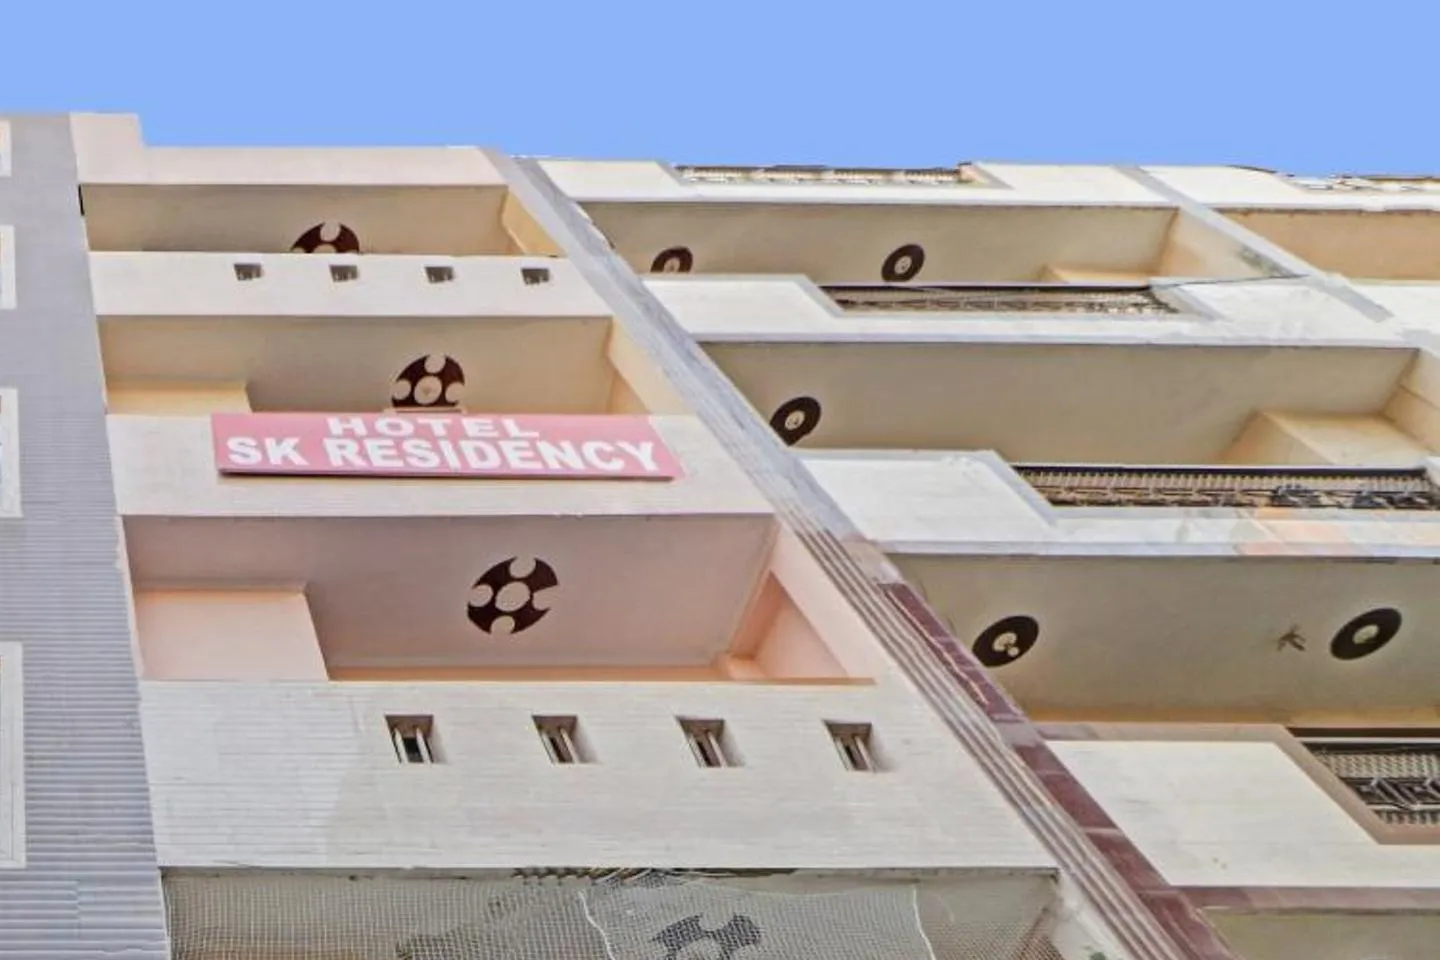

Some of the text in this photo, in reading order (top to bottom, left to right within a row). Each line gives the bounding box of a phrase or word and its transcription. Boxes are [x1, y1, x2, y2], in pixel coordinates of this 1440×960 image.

[327, 416, 540, 438] HOTEL
[226, 436, 660, 471] SK RESIDENCY
